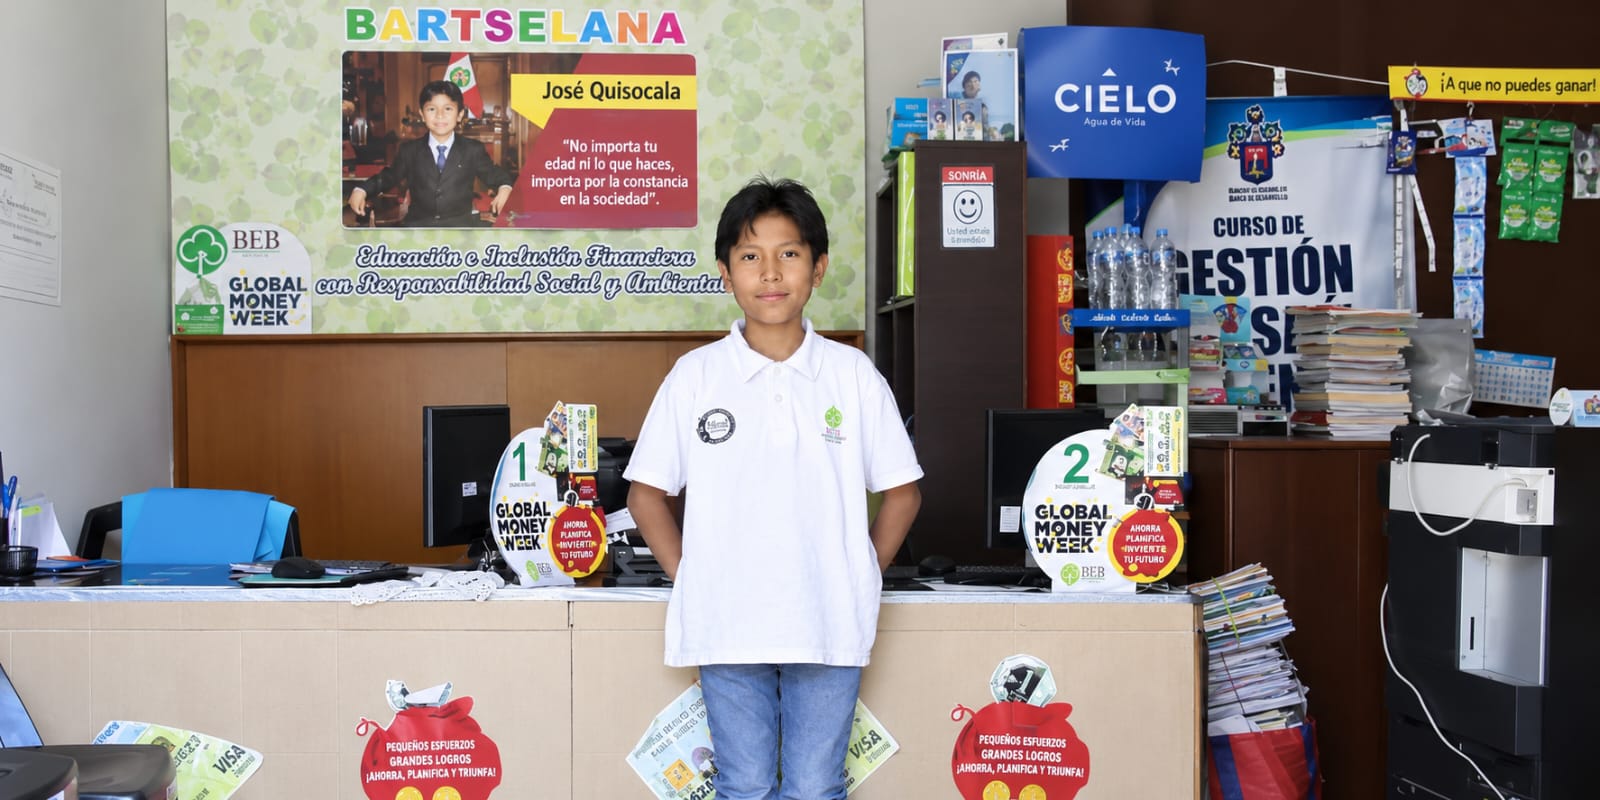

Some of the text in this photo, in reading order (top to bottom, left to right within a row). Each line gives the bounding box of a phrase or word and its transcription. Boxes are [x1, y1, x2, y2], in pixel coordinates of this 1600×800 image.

[345, 8, 687, 45] BARTSELANA
[542, 80, 681, 103] José Quisocala
[1440, 72, 1597, 95] ¡A que no puedes ganar!
[1054, 83, 1177, 114] CIELO
[1084, 116, 1147, 128] Agua de Vida
[591, 140, 640, 157] importa
[643, 141, 658, 153] tu
[545, 156, 675, 174] edad ni lo que haces,
[531, 174, 688, 191] importa por la constancia
[948, 169, 987, 181] SONRÍA
[560, 194, 576, 206] en
[579, 191, 591, 205] la
[1213, 215, 1304, 237] CURSO DE
[231, 229, 280, 250] BEB
[355, 244, 695, 268] Educación e Inclusión Financiera
[1176, 237, 1354, 297] GESTIÓN
[229, 276, 307, 292] GLOBAL
[315, 276, 353, 294] con
[356, 271, 529, 300] Responsabilidad
[534, 270, 600, 295] Social
[604, 277, 621, 301] y
[230, 293, 301, 309] MONEY
[230, 310, 289, 326] WEEK
[513, 442, 526, 482] 1
[1063, 443, 1090, 484] 2
[496, 501, 551, 519] GLOBAL
[1034, 504, 1113, 520] GLOBAL
[498, 518, 548, 535] MONEY
[1035, 520, 1107, 537] MONEY
[1130, 524, 1161, 533] AHORRA
[501, 534, 542, 551] WEEK
[1035, 537, 1095, 554] WEEK
[1081, 566, 1105, 578] BEB
[386, 739, 475, 753] PEQUEÑOS ESFUERZOS
[849, 729, 883, 760] VISA
[979, 733, 1067, 748] PEQUEÑOS ESFUERZOS
[212, 744, 247, 774] VISA
[390, 754, 471, 767] GRANDES LOGROS
[981, 749, 1062, 762] GRANDES LOGROS
[366, 767, 496, 783] ¡AHORRA, PLANIFICA Y TRIUNFA!
[956, 763, 1084, 778] ¡AHORRA, PLANIFICA Y TRIUNFA!
